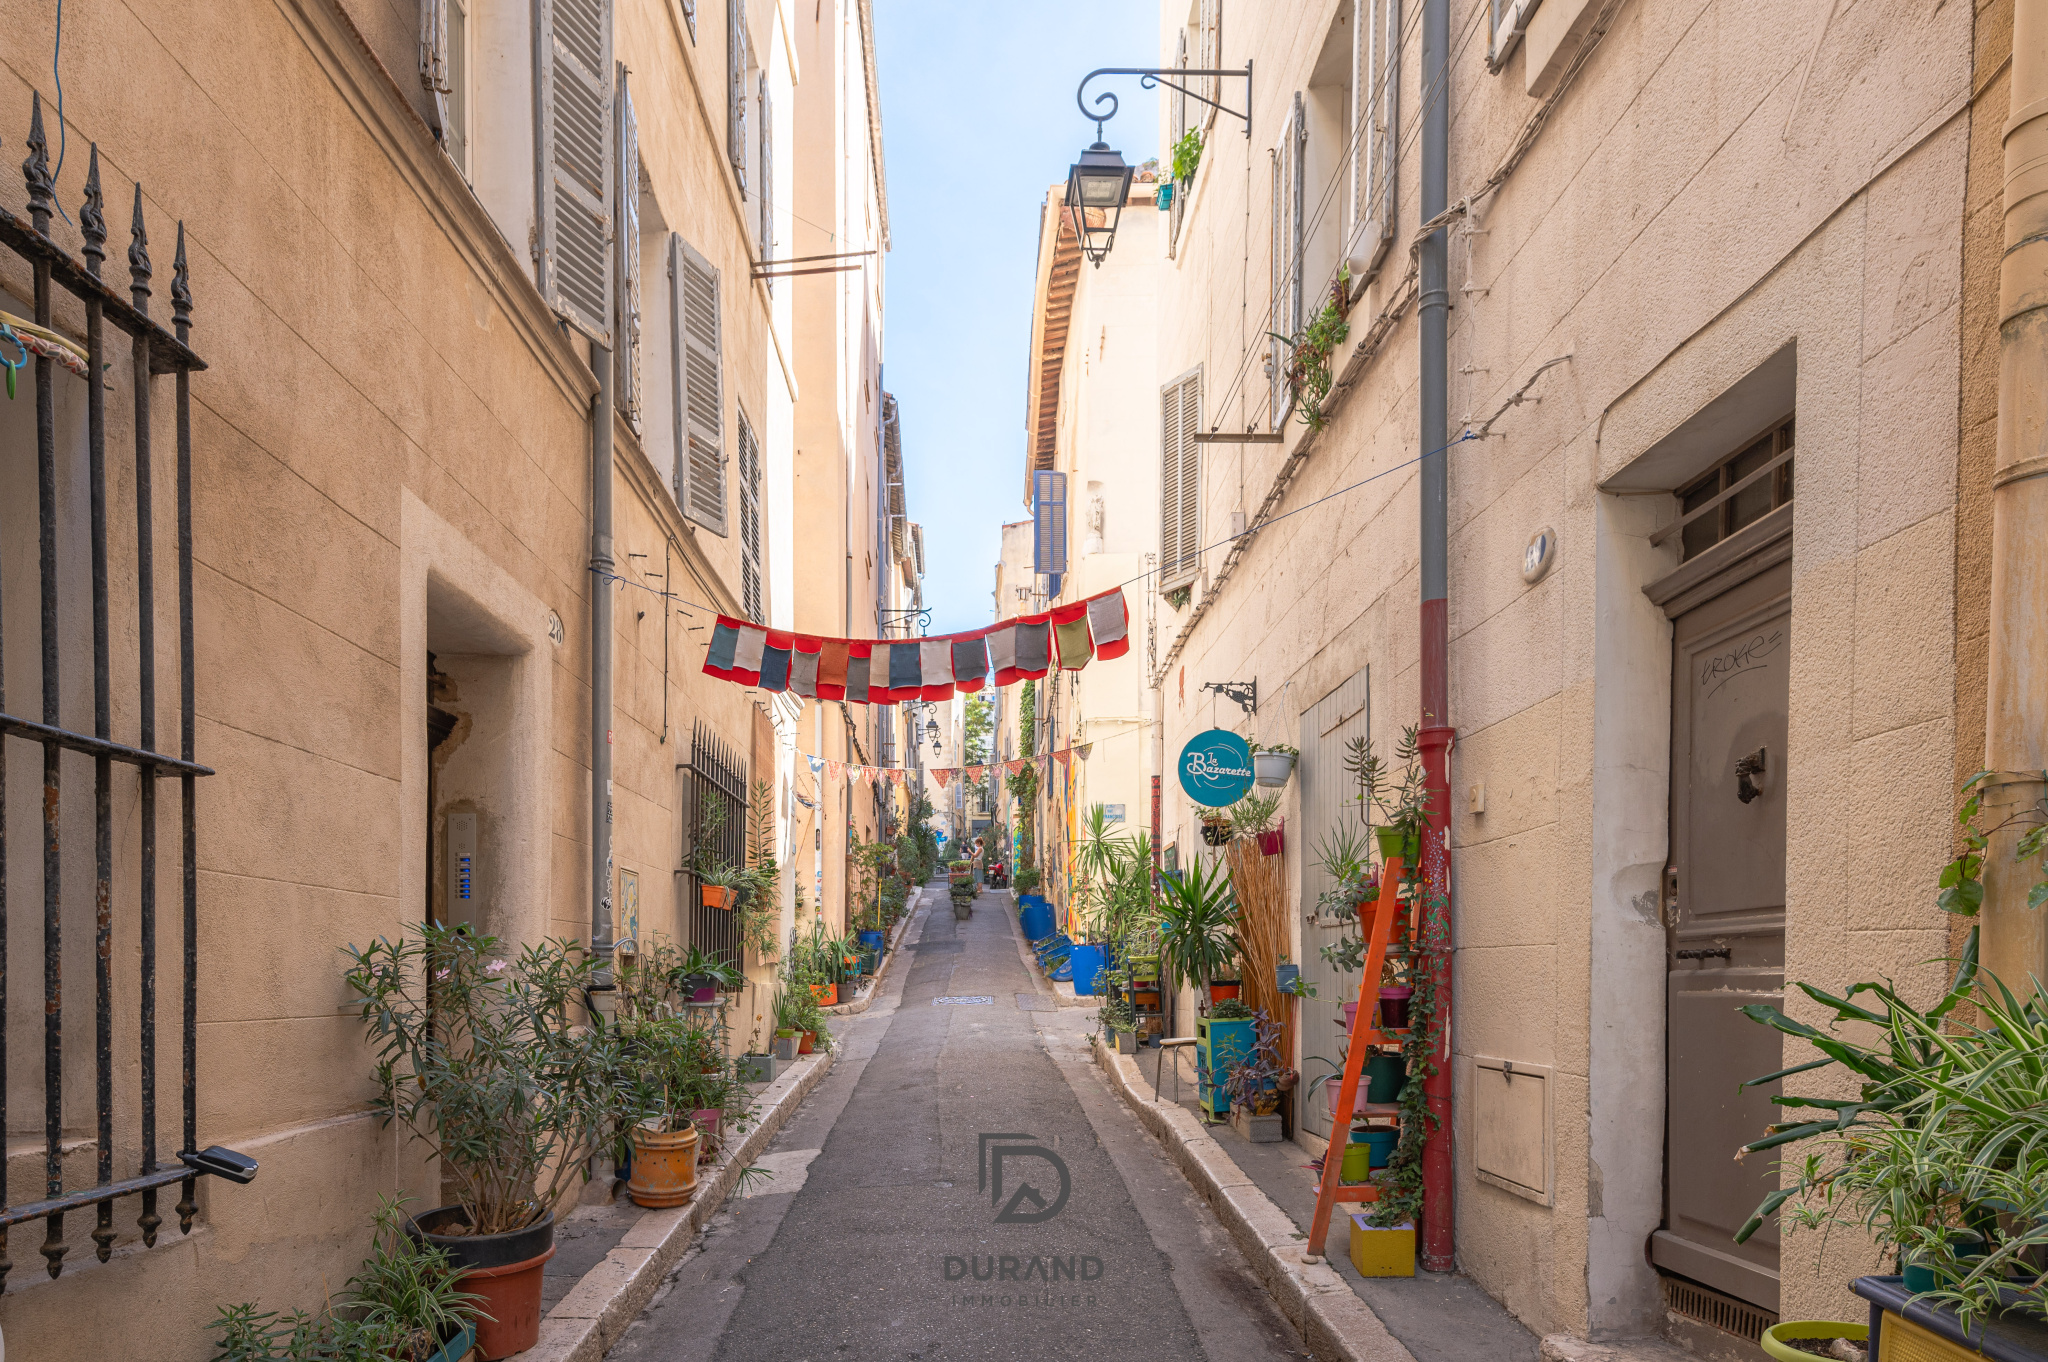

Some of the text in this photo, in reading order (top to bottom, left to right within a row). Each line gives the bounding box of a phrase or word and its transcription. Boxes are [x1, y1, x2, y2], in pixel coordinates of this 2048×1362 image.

[549, 614, 562, 643] 28
[1186, 752, 1252, 781] Bazarette
[1206, 752, 1218, 767] La
